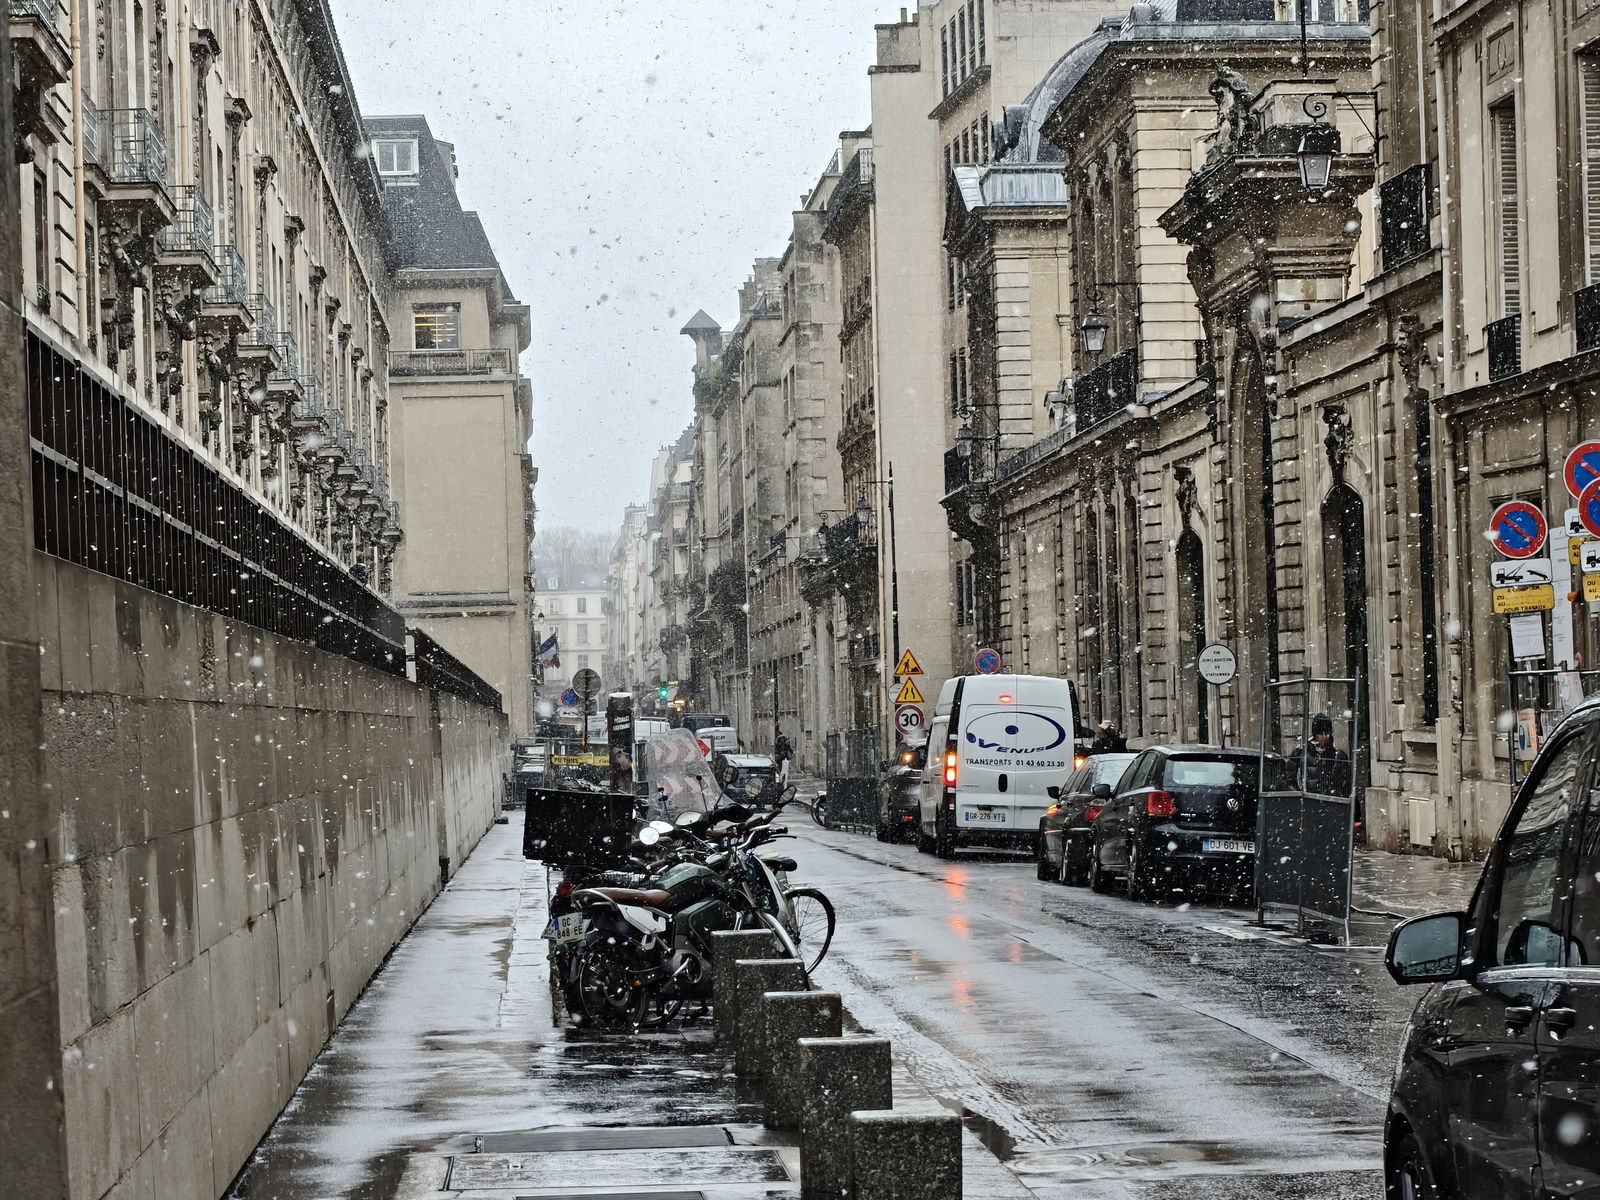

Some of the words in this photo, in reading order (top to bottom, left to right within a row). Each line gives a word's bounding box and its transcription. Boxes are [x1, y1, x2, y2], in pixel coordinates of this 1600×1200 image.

[901, 713, 919, 727] 30
[978, 738, 1045, 754] VENUS
[965, 758, 1012, 766] TRANSPORTS
